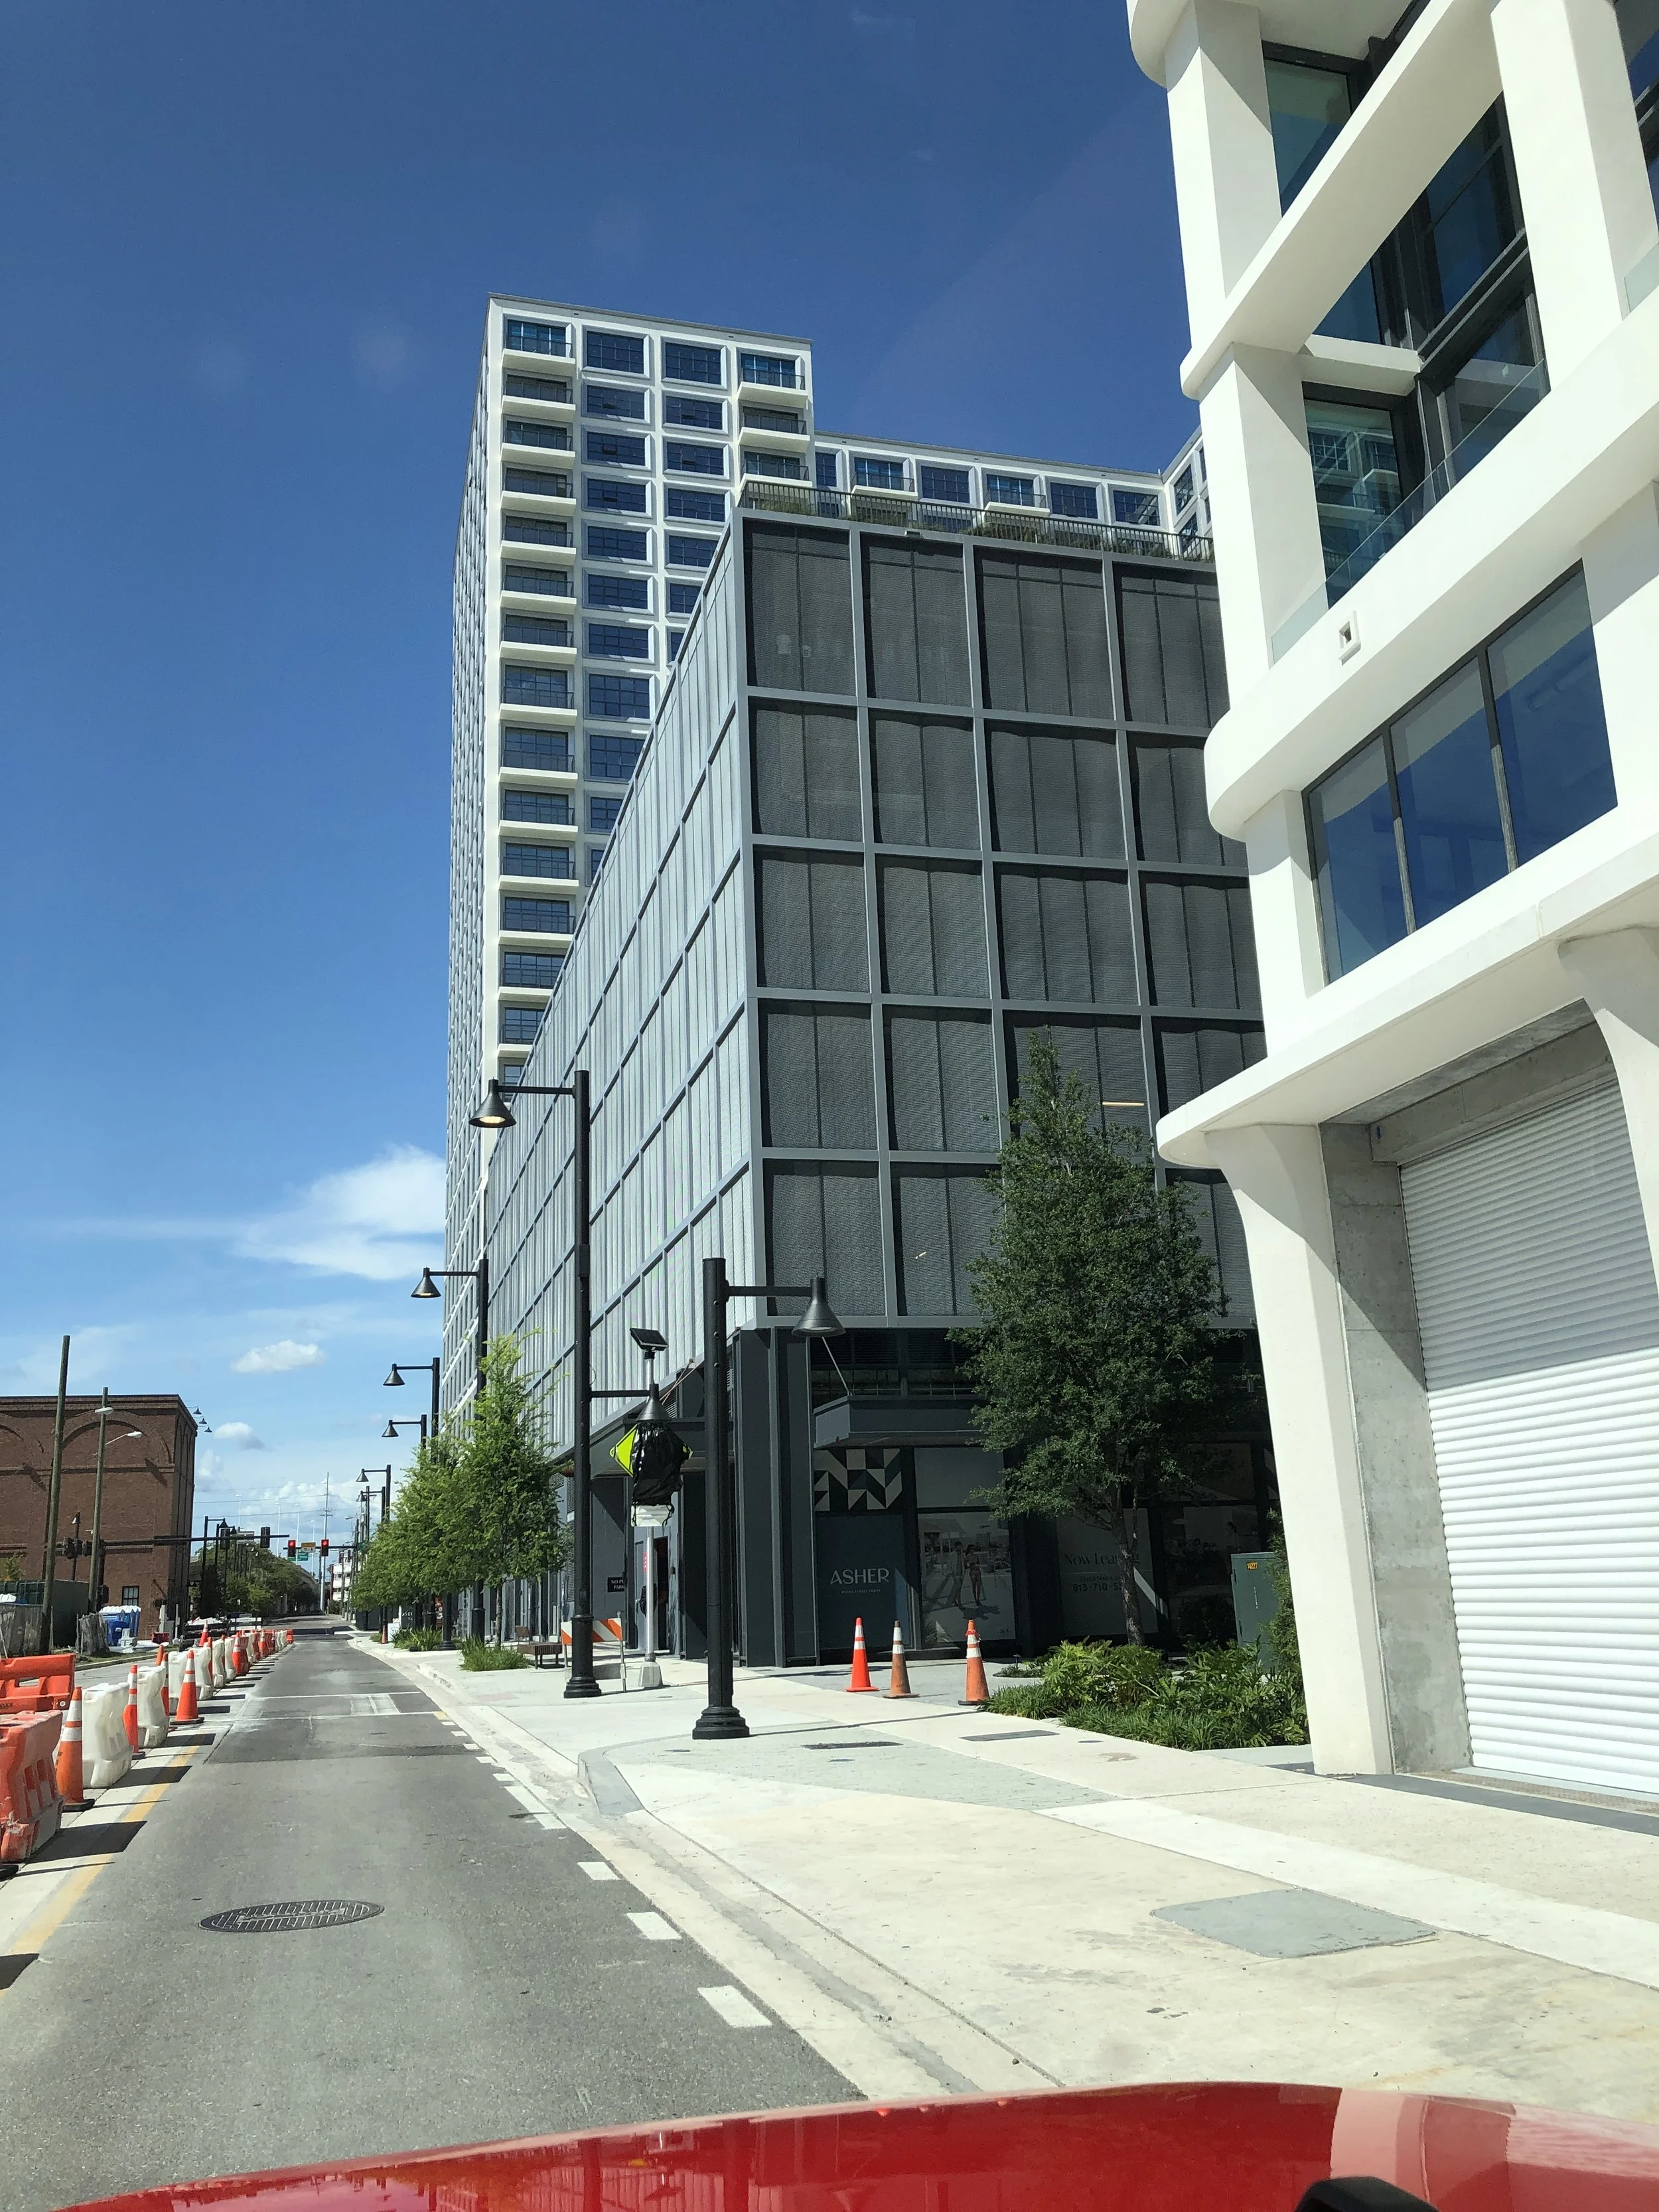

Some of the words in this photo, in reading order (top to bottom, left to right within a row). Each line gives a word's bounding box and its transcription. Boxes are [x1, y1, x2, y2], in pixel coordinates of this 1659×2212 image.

[1064, 1553, 1090, 1565] Now
[1094, 1552, 1141, 1565] Leag
[830, 1568, 889, 1585] ASHER
